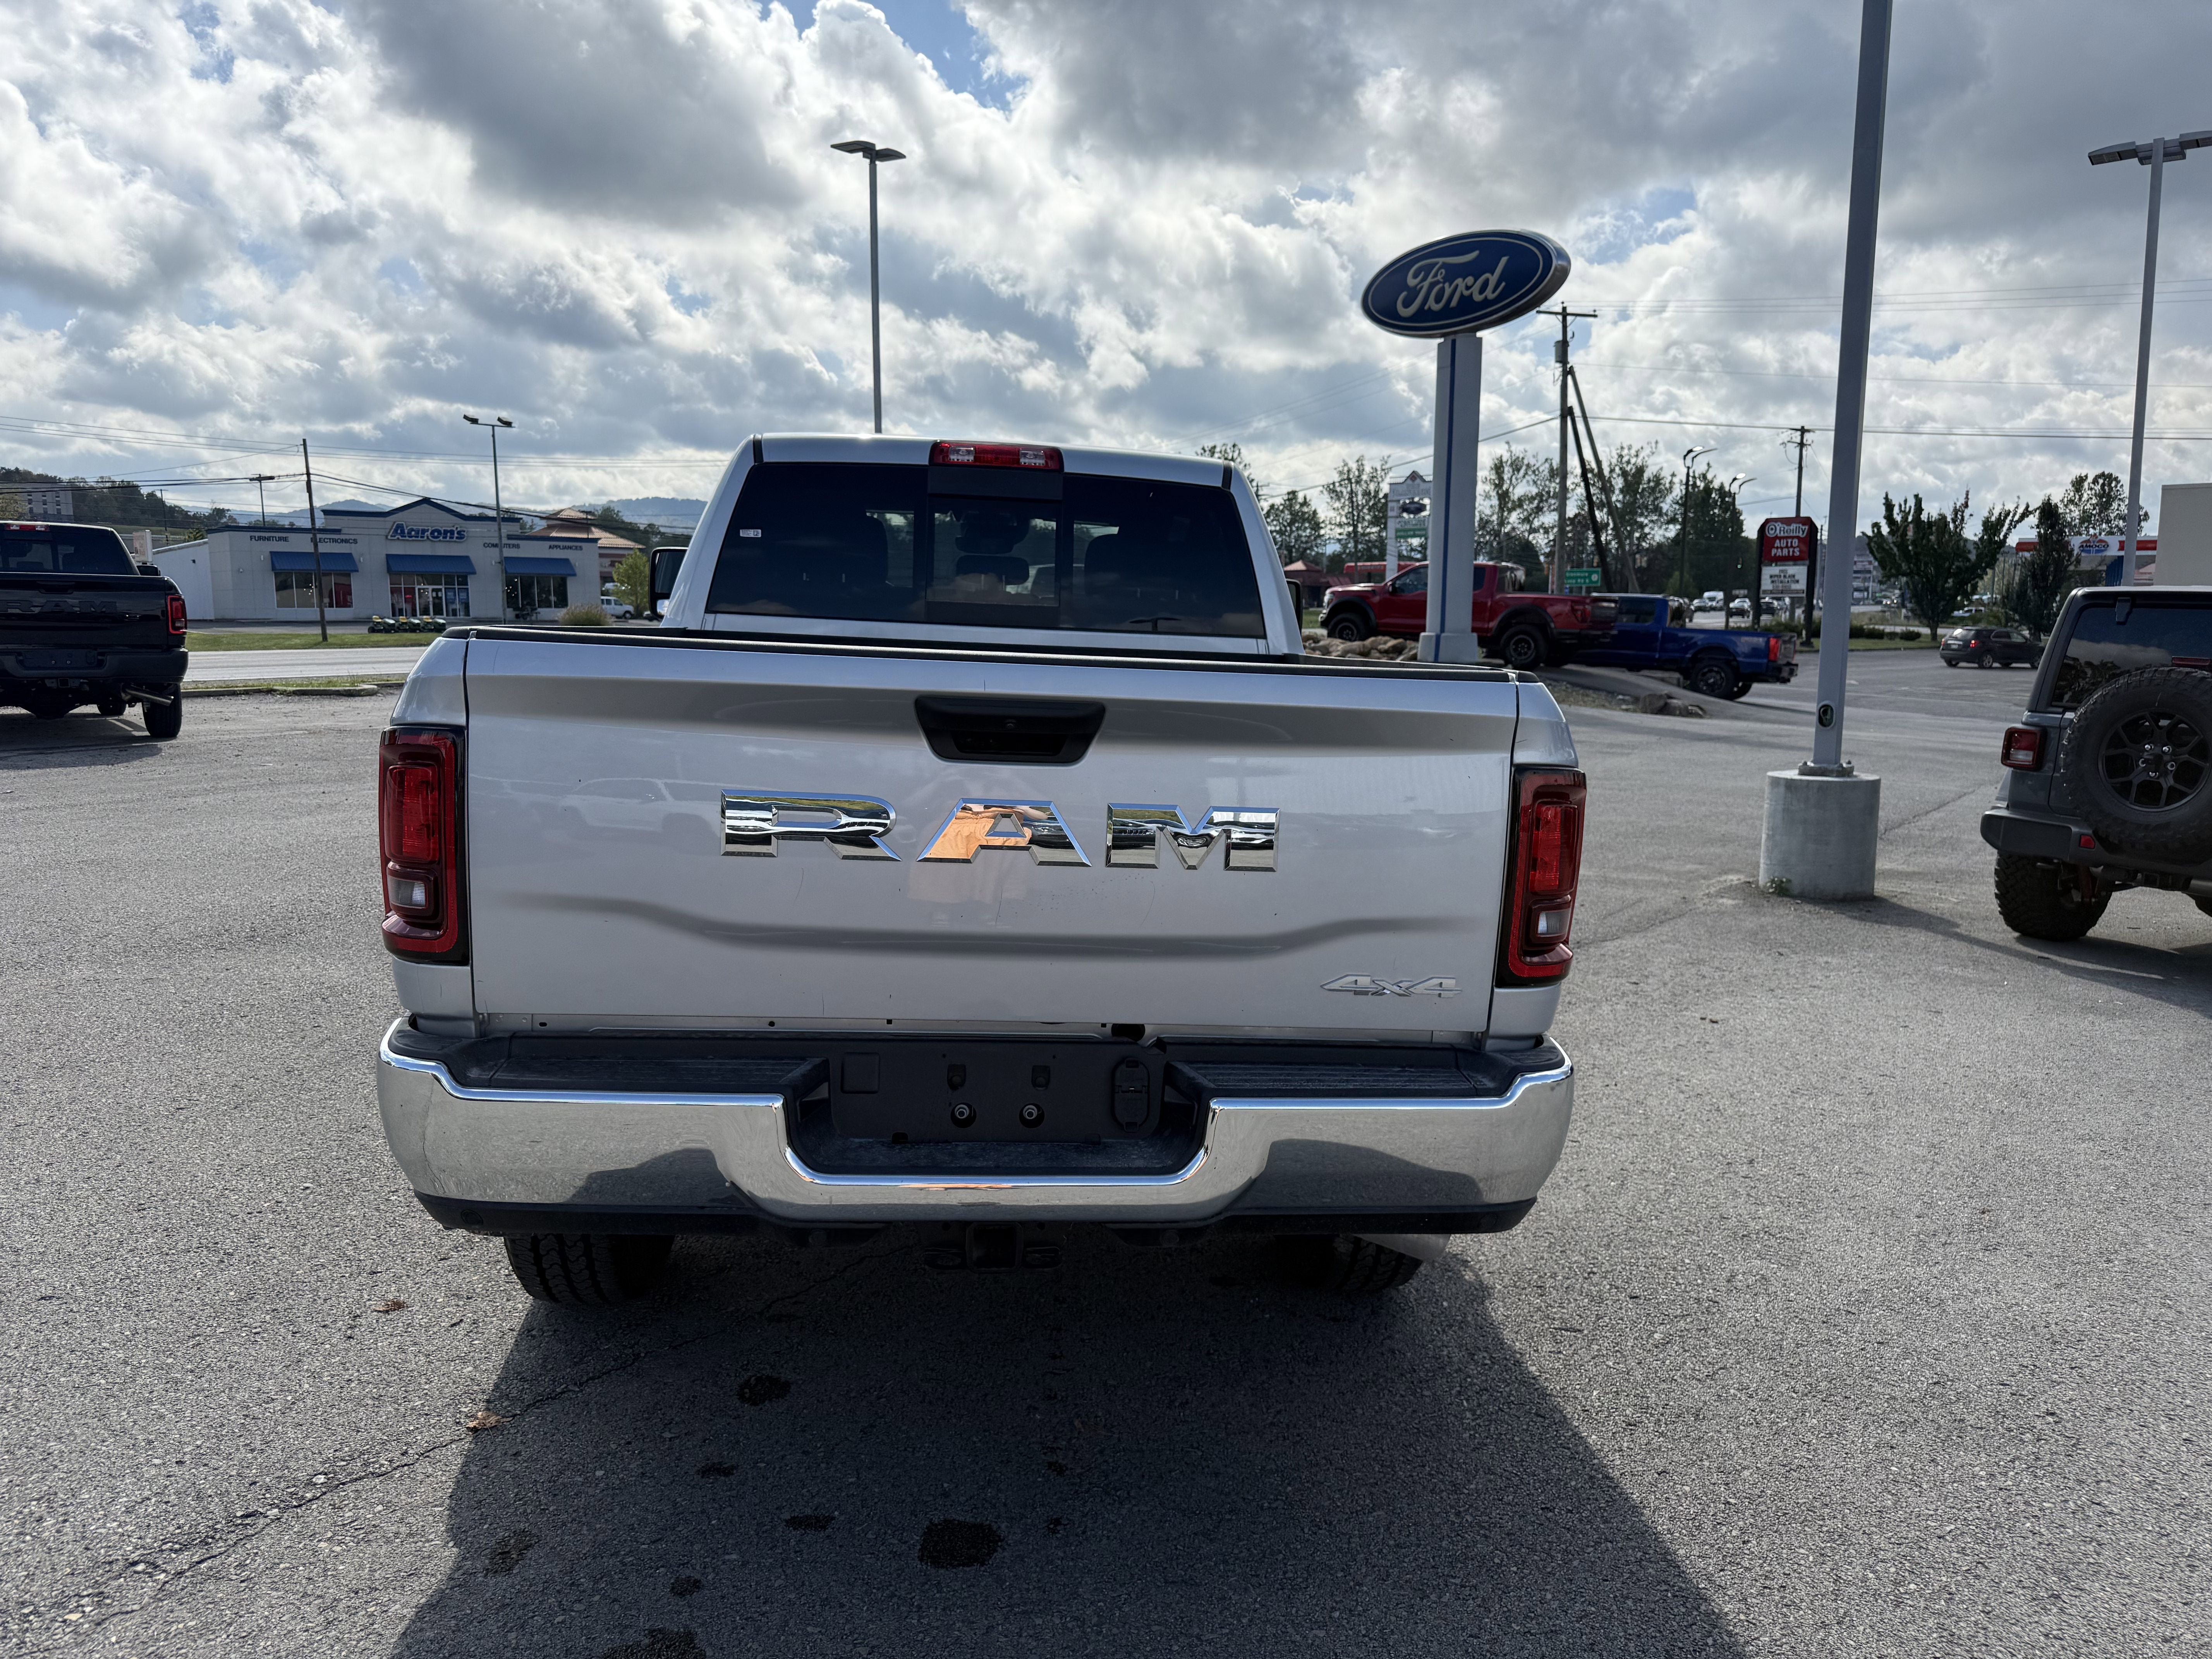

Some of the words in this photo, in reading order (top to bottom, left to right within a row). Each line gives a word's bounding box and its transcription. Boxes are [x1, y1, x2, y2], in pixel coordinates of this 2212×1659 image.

[1397, 250, 1510, 318] Ford
[388, 522, 467, 541] Aaron's
[1766, 522, 1808, 538] O'Reilly
[1774, 539, 1798, 547] AUTO
[1771, 548, 1800, 556] PARTS
[0, 600, 117, 613] RAM
[721, 789, 1281, 872] RAM
